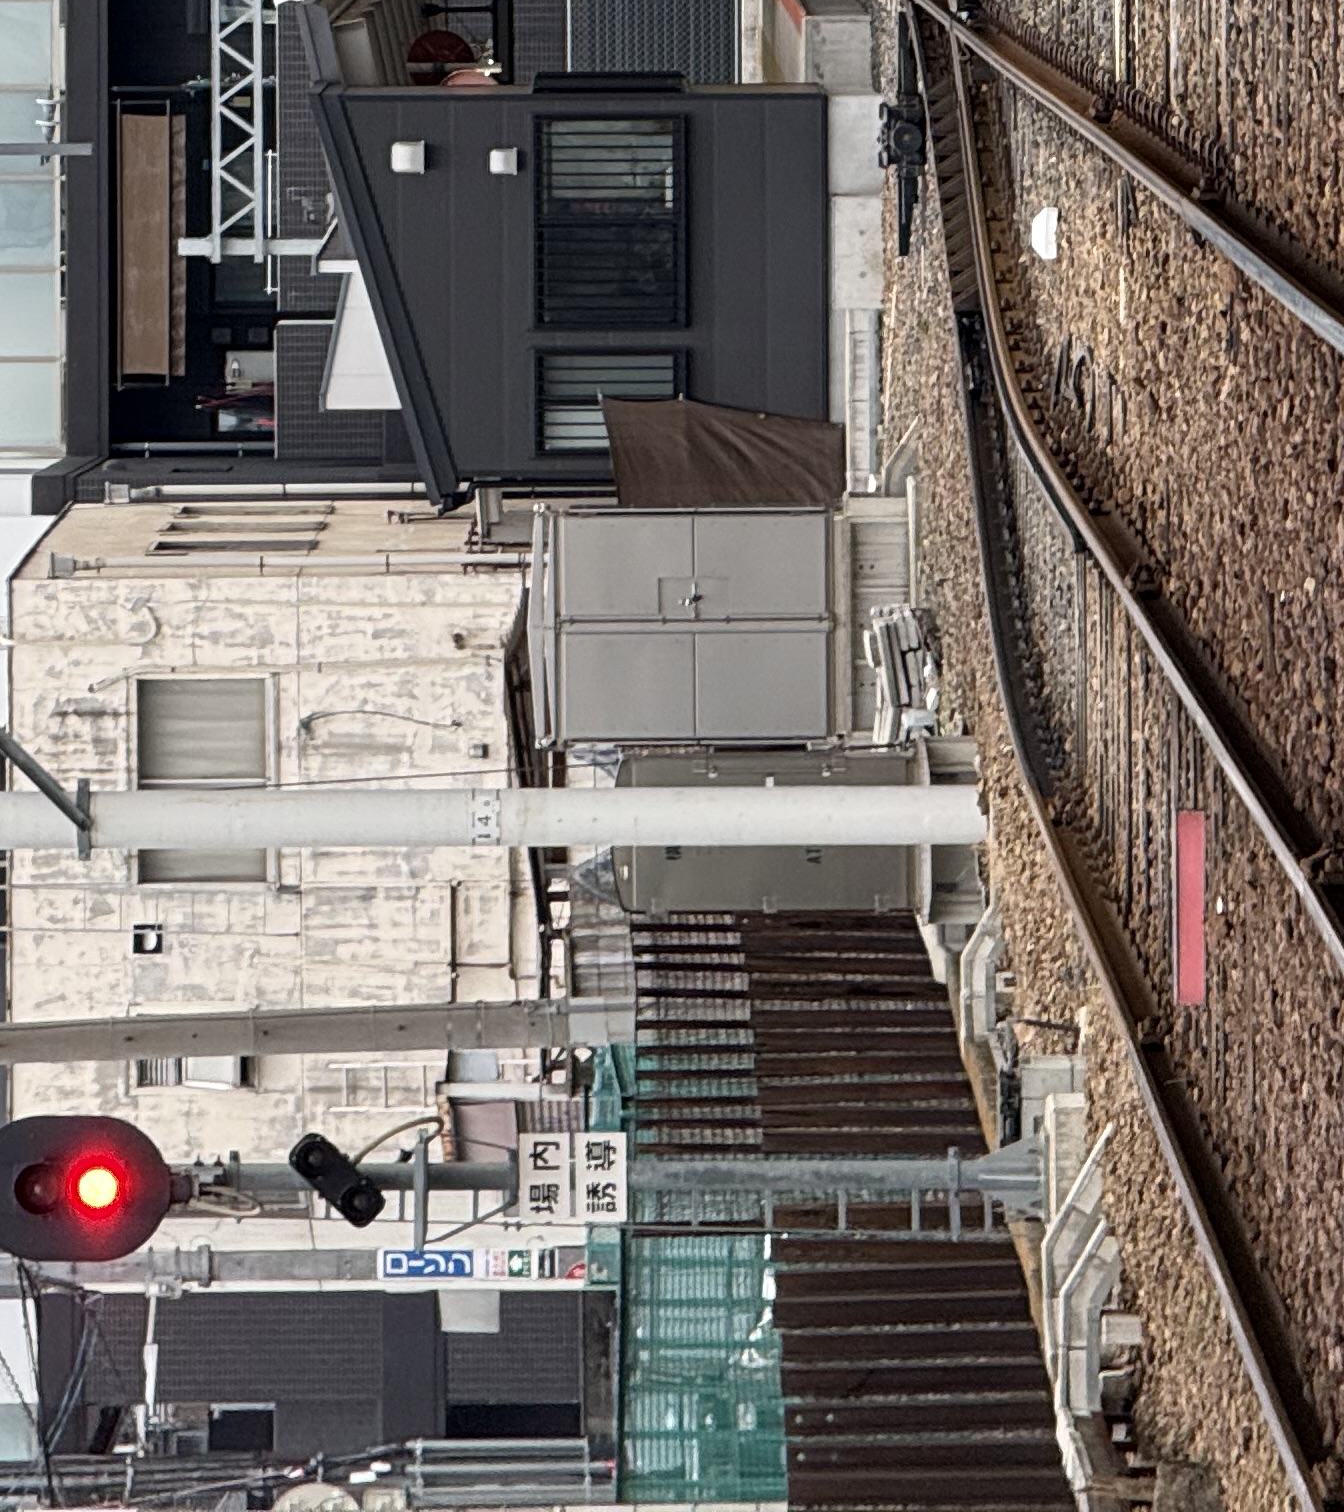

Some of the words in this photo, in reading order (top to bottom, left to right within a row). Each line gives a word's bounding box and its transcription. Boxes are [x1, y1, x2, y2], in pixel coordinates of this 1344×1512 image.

[805, 846, 823, 864] AT
[529, 1140, 560, 1214] 場内
[584, 1139, 617, 1214] 誘導
[386, 1252, 471, 1274] ローソン
